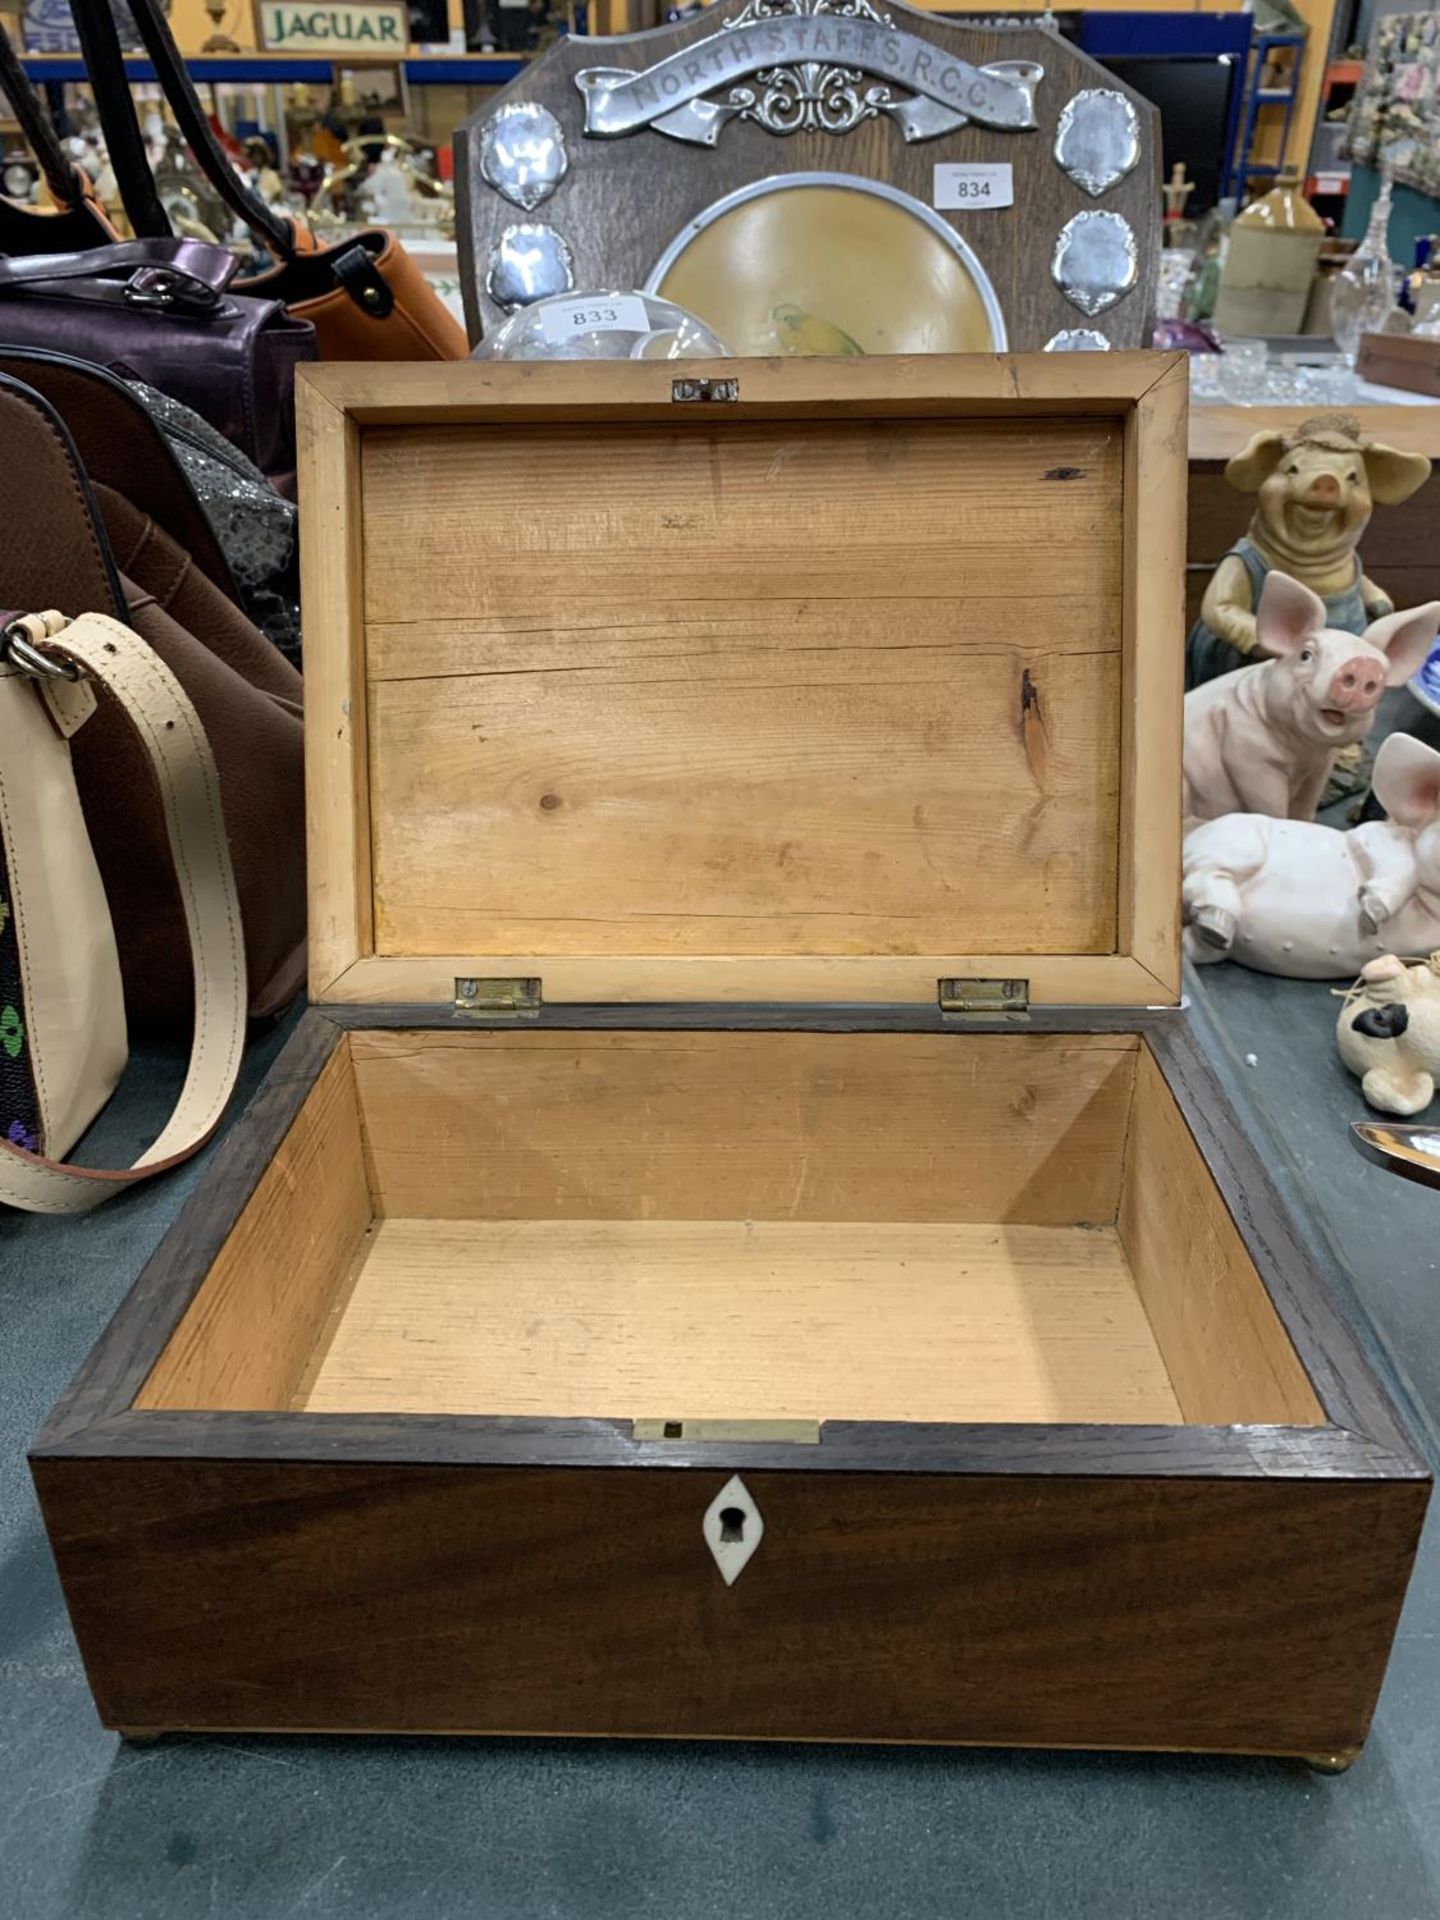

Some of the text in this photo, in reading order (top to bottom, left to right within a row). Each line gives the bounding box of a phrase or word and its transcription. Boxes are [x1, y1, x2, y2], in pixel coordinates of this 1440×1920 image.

[272, 9, 399, 42] JAGUAR
[630, 33, 754, 110] NORTH
[958, 181, 991, 198] 834
[573, 309, 618, 325] 833
